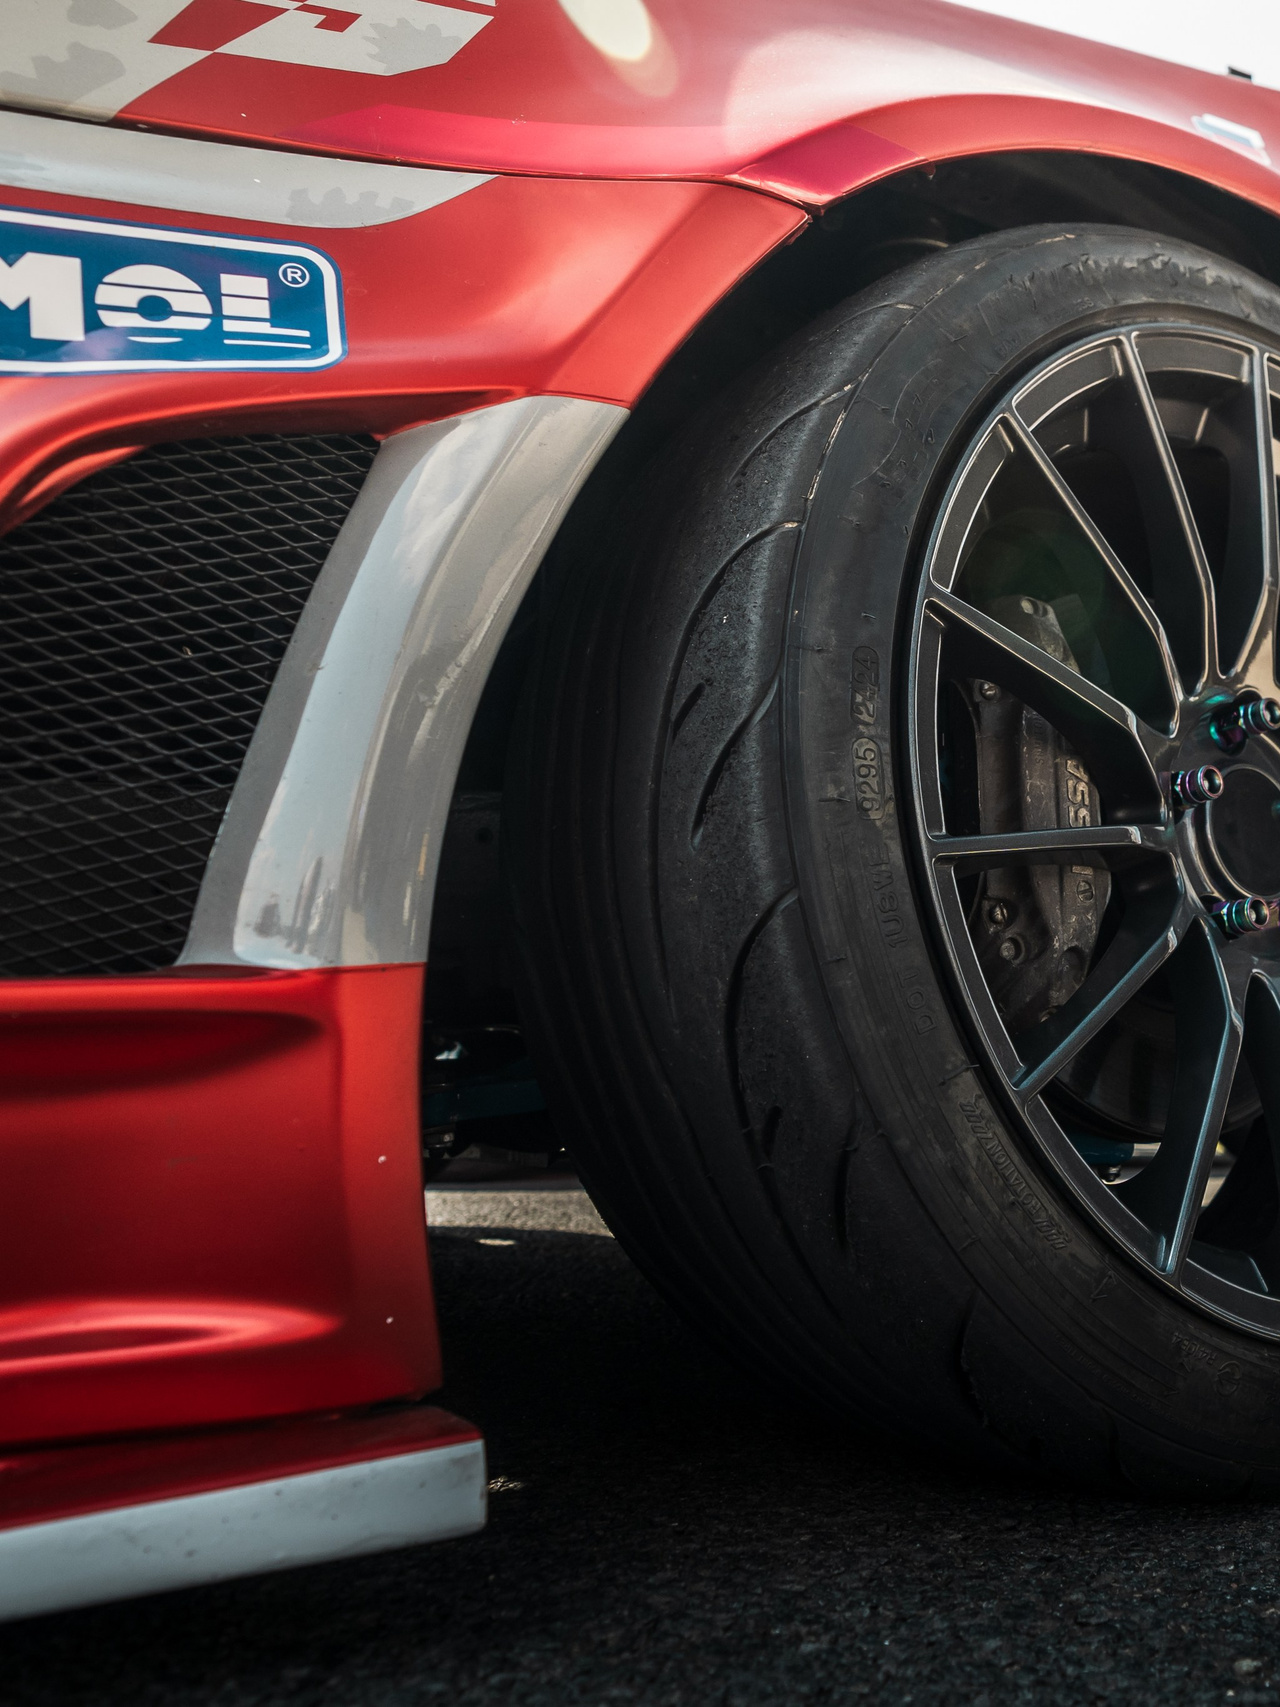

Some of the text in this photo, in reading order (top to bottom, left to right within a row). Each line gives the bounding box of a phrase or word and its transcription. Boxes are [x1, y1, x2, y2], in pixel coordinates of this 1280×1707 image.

[853, 654, 877, 719] 2424
[854, 745, 882, 814] 9295
[897, 967, 936, 1037] DOT
[985, 1139, 1042, 1218] ROTATION
